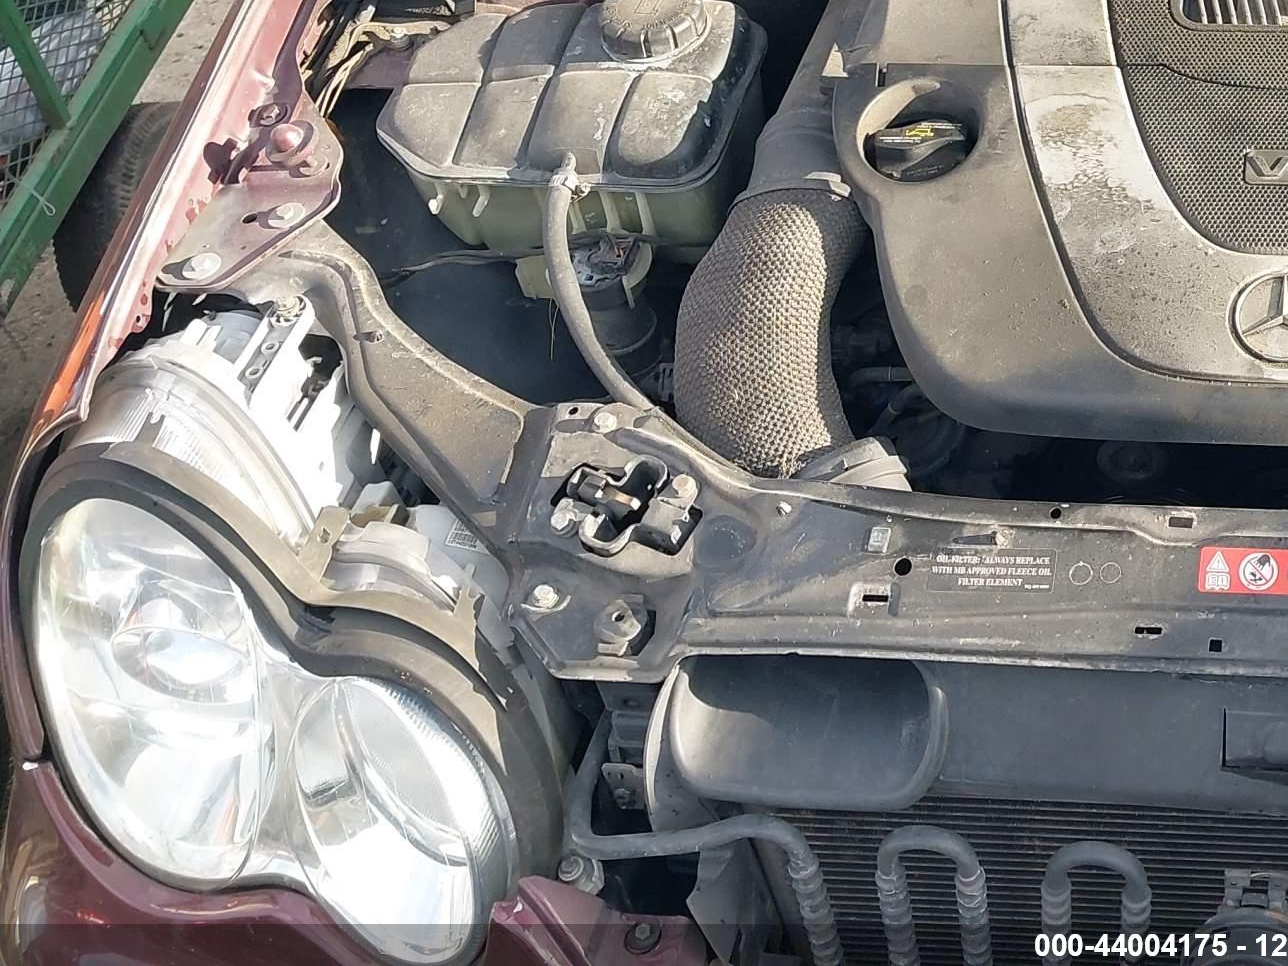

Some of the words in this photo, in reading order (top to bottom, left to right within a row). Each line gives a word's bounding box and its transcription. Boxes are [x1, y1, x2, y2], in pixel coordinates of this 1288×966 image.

[1016, 556, 1051, 565] REPLACE
[932, 566, 953, 574] WITH
[953, 566, 966, 575] MB
[967, 567, 1007, 575] APPROVED
[1007, 567, 1037, 576] FLEECE
[957, 577, 984, 586] FILTER
[985, 578, 1023, 586] ELEMENT
